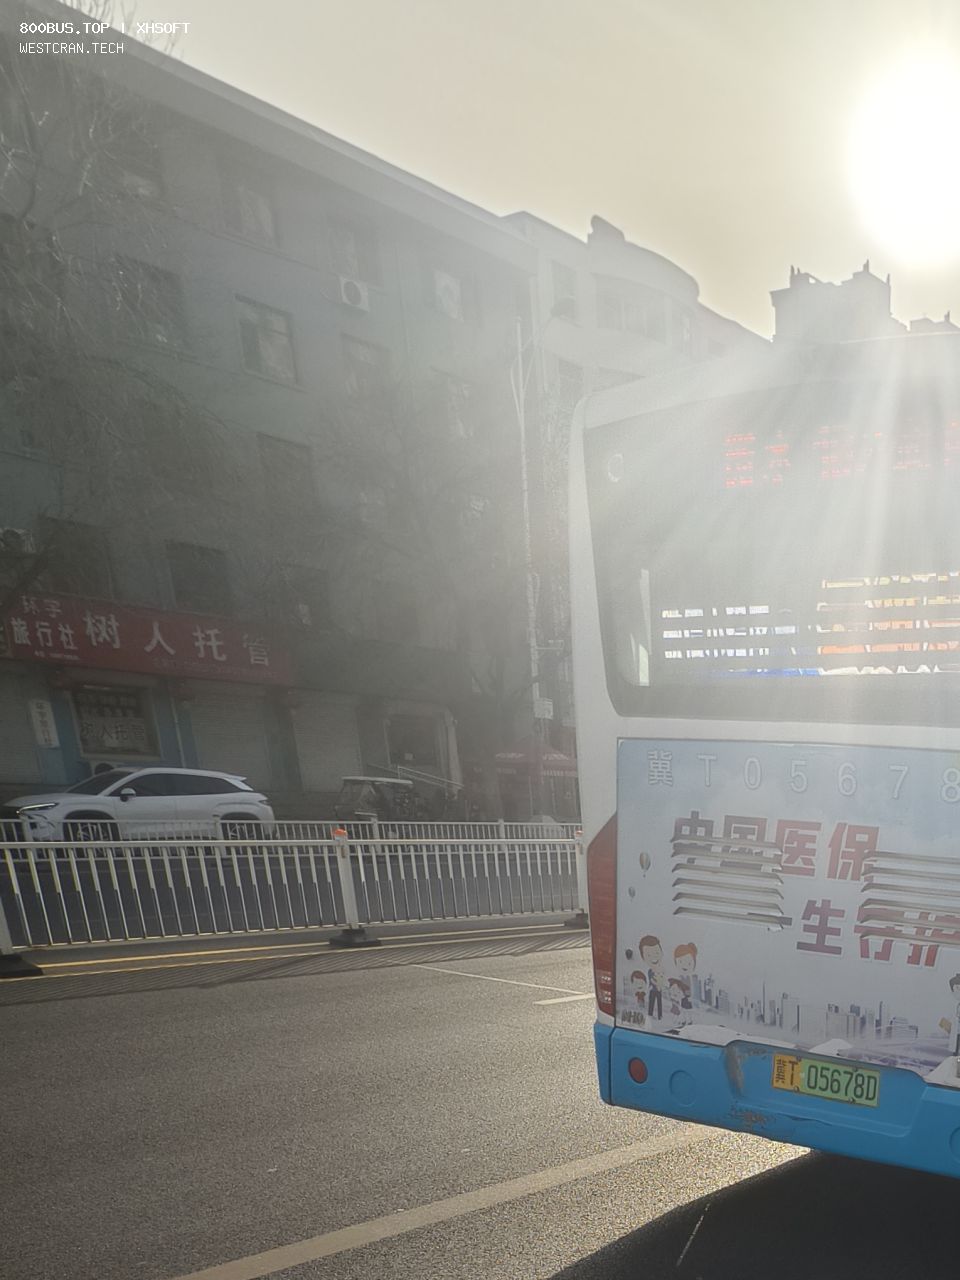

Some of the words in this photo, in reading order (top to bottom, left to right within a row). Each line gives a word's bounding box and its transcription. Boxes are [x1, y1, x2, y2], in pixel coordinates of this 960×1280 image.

[11, 616, 78, 650] 旅行社
[83, 611, 270, 667] 树人托管
[671, 810, 879, 882] 中国医保
[774, 1059, 878, 1101] 冀T05678D
